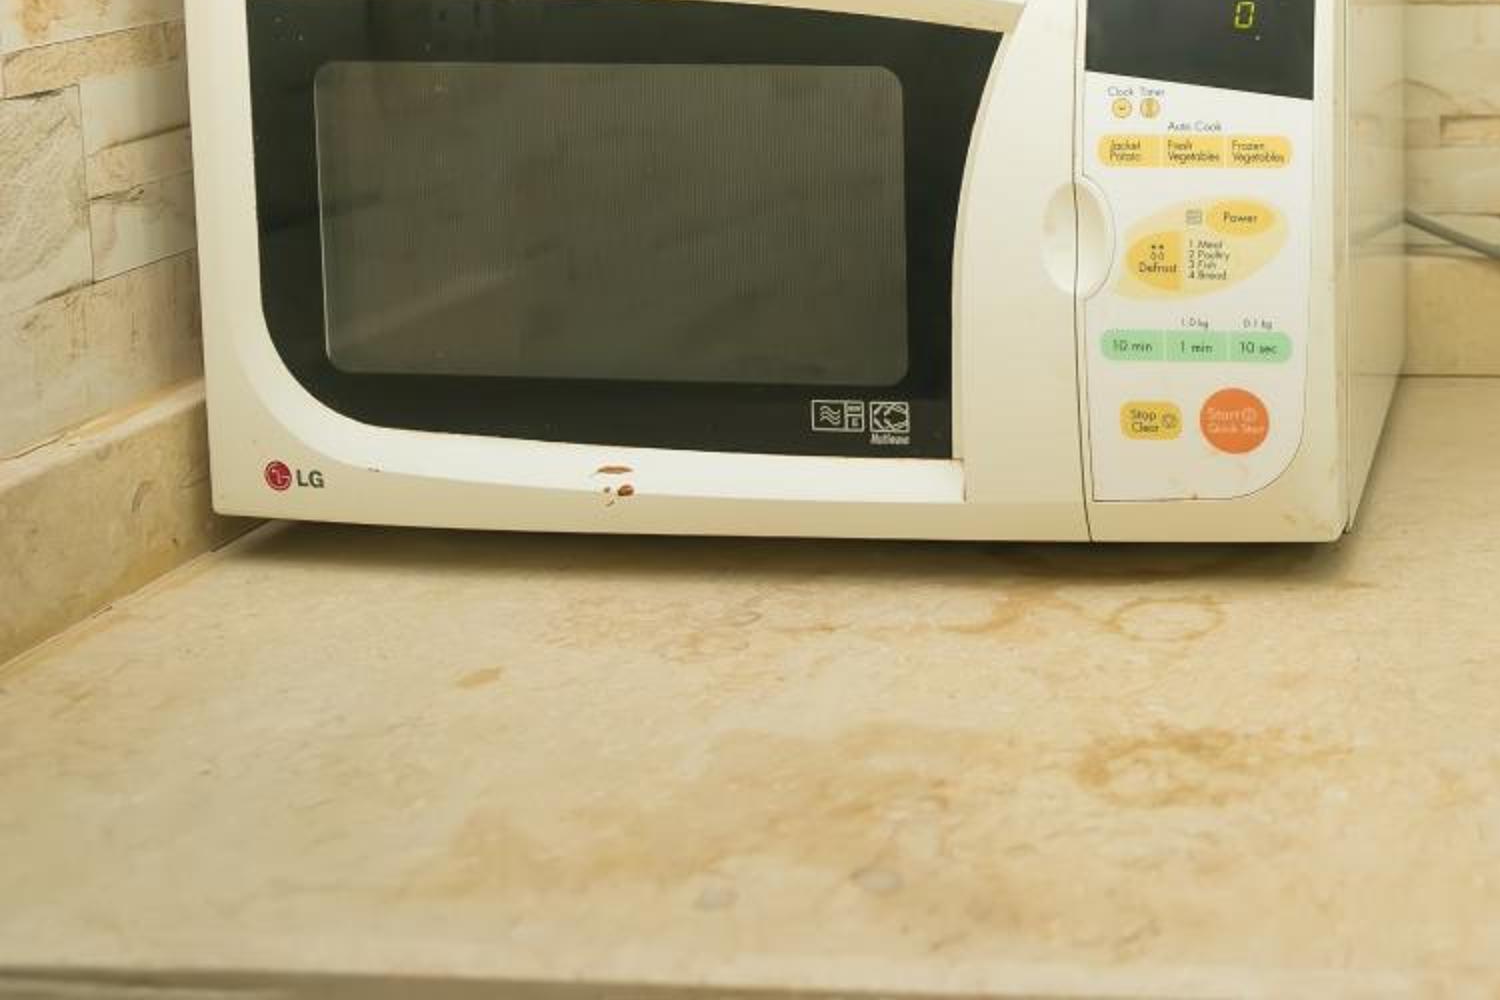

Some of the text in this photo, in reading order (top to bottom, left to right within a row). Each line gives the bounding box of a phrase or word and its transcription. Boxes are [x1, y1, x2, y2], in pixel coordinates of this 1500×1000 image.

[1235, 1, 1256, 29] 0
[1107, 86, 1134, 97] Clock
[1194, 120, 1222, 132] Cook
[1110, 139, 1141, 151] Jacket
[1231, 139, 1265, 151] Frozen
[1167, 150, 1221, 163] Vegetables
[1231, 151, 1285, 164] Vegetables
[1223, 211, 1258, 224] Power
[1138, 262, 1177, 273] Defrost
[1112, 339, 1153, 352] 10 min
[1191, 342, 1213, 353] min
[1240, 341, 1277, 354] 10 sec
[1129, 409, 1157, 422] Stop
[1131, 421, 1160, 433] Clear
[296, 469, 325, 489] LG
